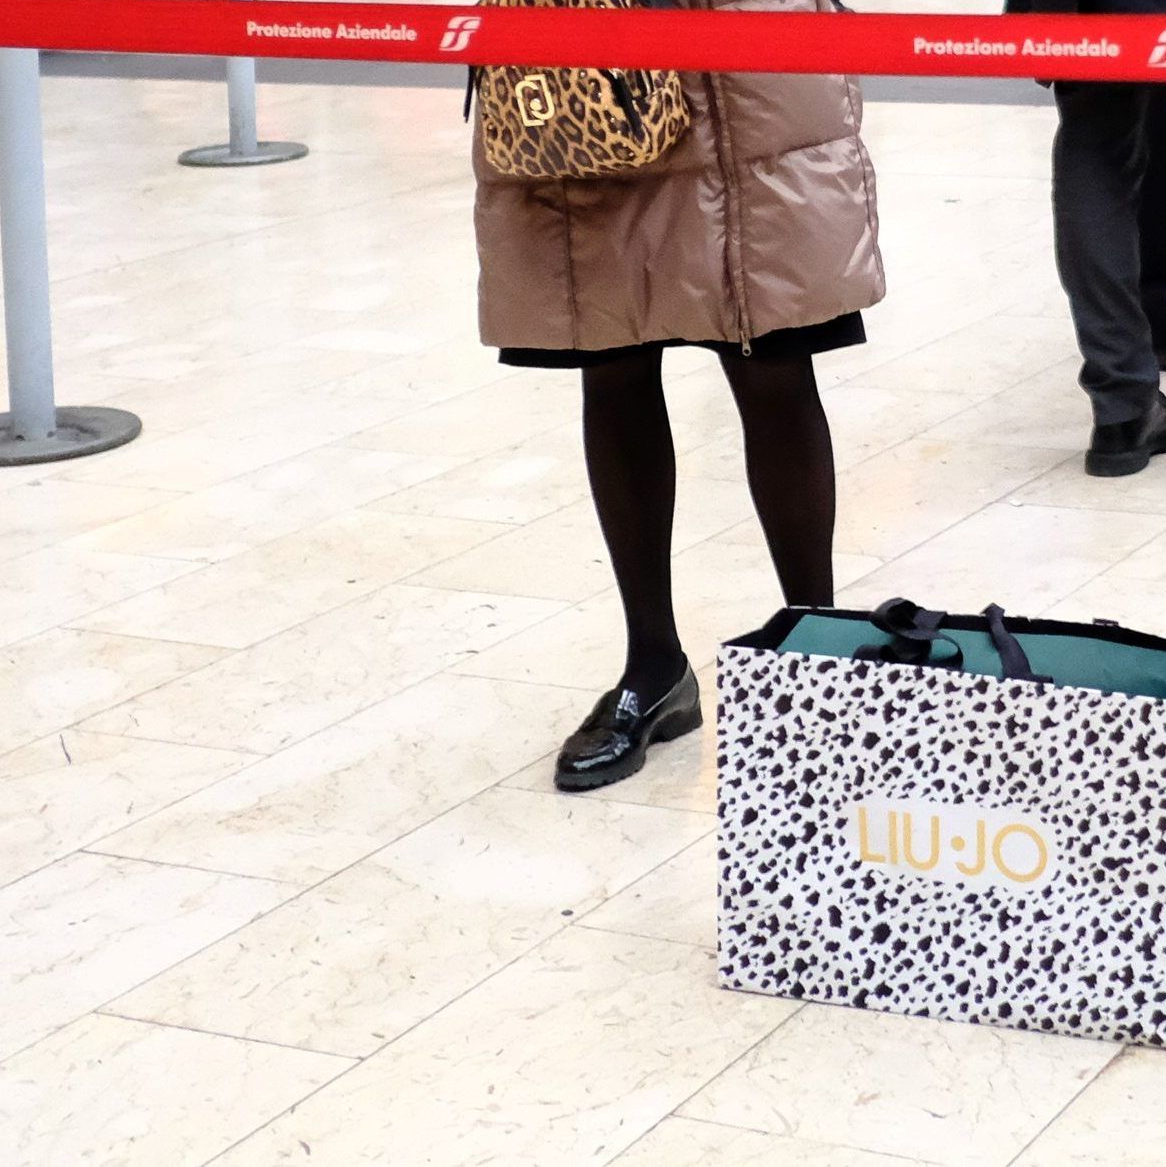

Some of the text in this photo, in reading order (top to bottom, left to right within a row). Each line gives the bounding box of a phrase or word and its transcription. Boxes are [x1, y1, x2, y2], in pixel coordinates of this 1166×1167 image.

[246, 21, 417, 41] Protezione Aziendale
[913, 37, 1121, 58] Protezione Aziendale
